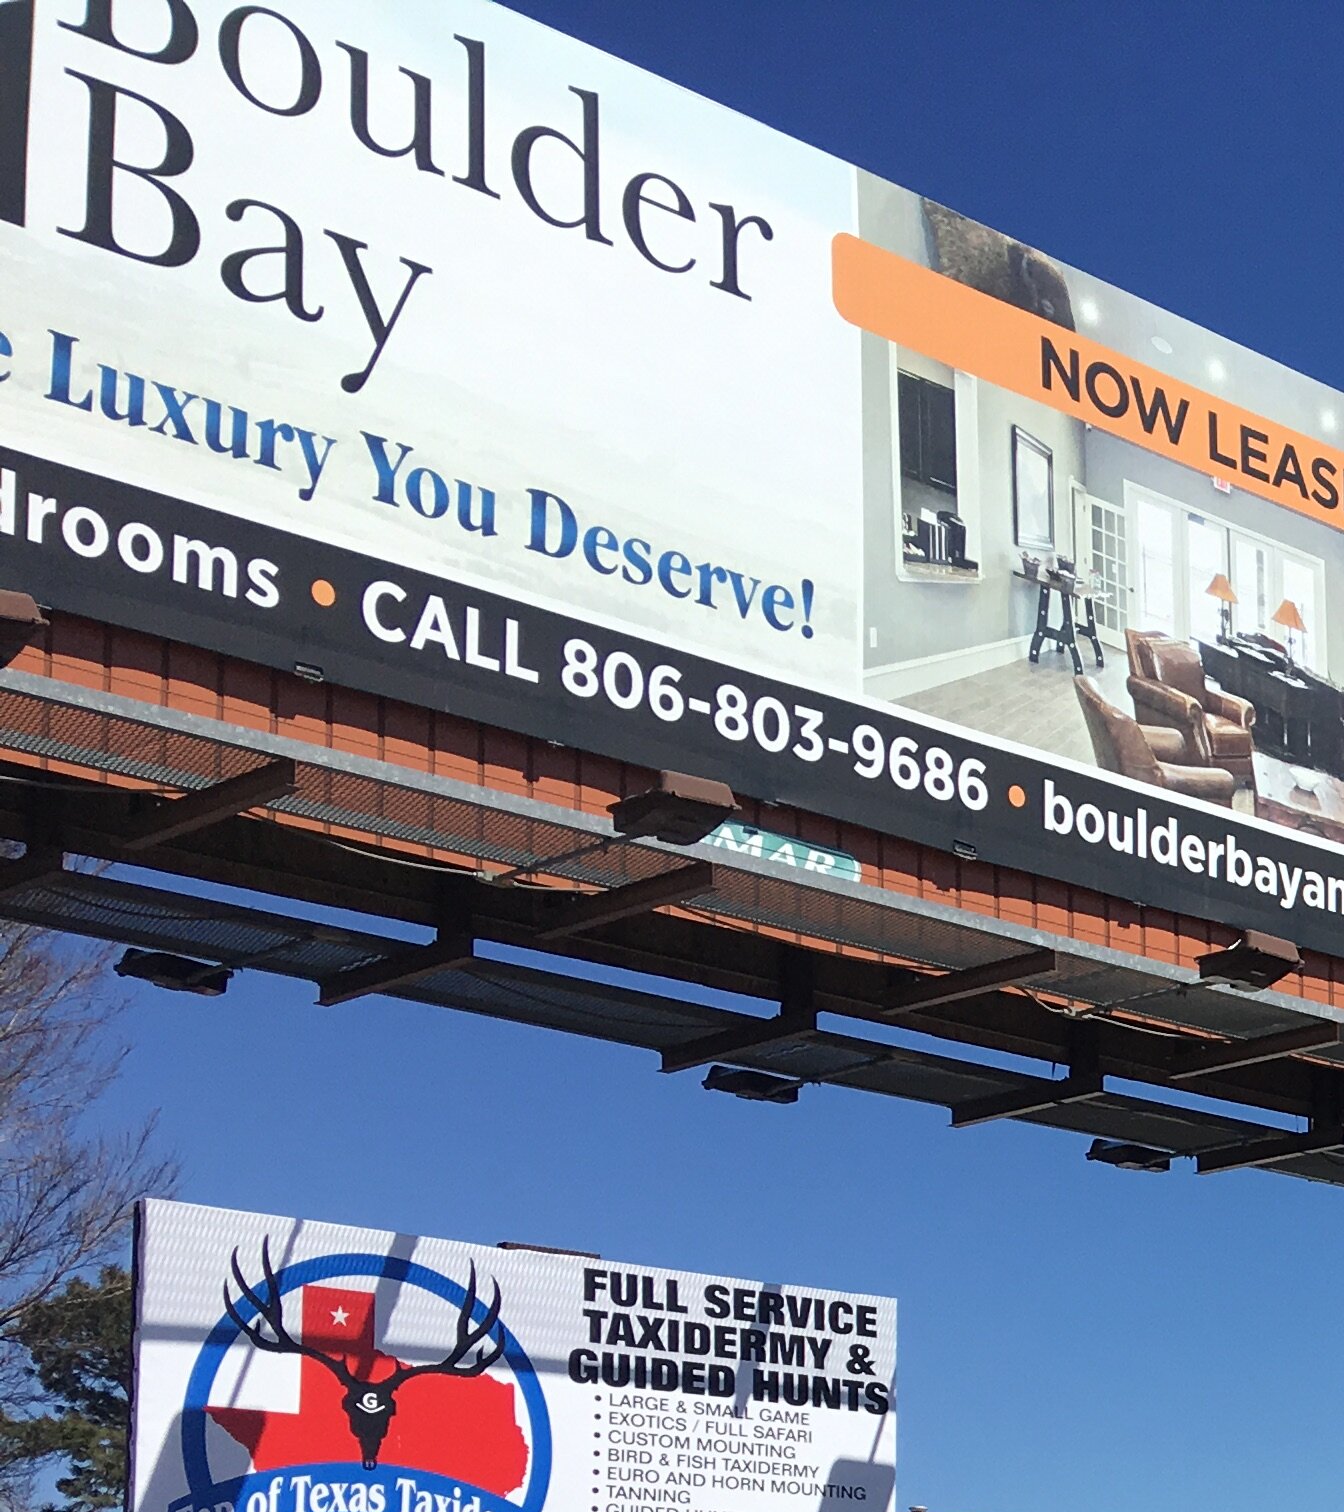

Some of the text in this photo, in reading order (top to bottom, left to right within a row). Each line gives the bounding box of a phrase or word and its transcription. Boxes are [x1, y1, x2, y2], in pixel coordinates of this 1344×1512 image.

[56, 67, 433, 393] Bay
[1041, 336, 1189, 447] NOW
[43, 329, 816, 640] Luxury You Deserve!
[361, 581, 540, 683] CALL
[561, 638, 989, 811] 806-803-9686
[583, 1267, 878, 1338] FULL SERVICE
[582, 1308, 877, 1376] TAXIDERMY &
[357, 1392, 378, 1409] G
[568, 1348, 889, 1415] GUIDED HUNTS
[608, 1411, 813, 1444] EXOTICS / FULL SAFARI
[609, 1394, 810, 1426] LARGE & SMALL GAME
[607, 1448, 821, 1479] BIRD & FISH TAXIDERMY
[608, 1430, 796, 1459] CUSTOM MOUNTING
[606, 1484, 691, 1504] TANNING
[607, 1467, 867, 1501] EURO AND HORN MOUNTING
